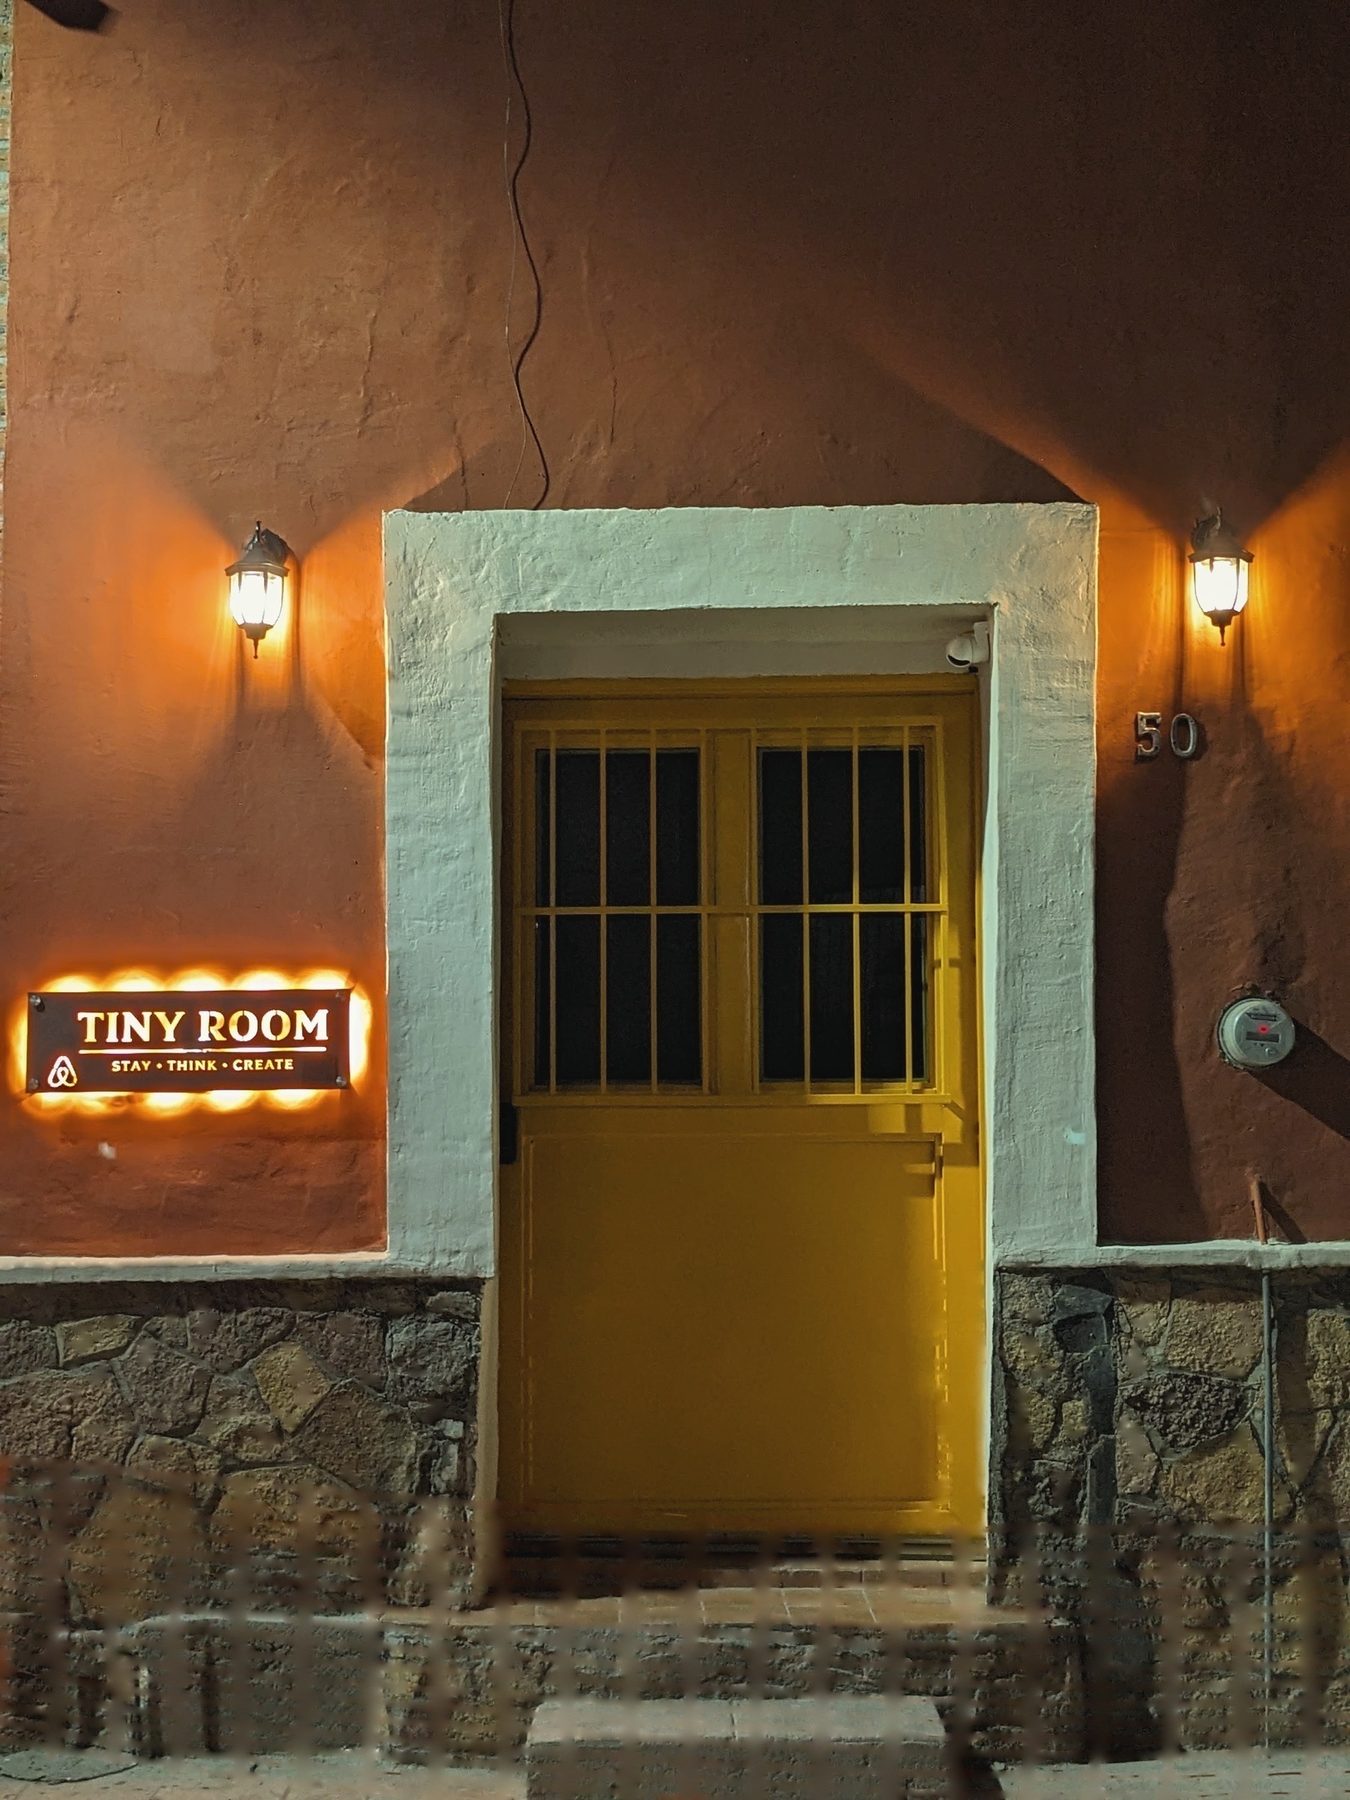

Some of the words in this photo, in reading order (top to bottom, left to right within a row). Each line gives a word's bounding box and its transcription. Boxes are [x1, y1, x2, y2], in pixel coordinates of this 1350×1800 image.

[1137, 711, 1198, 757] 50
[78, 1011, 185, 1043] TINY
[198, 1009, 328, 1041] ROOM
[111, 1060, 151, 1072] STAY
[167, 1060, 217, 1071] THINK
[232, 1059, 294, 1071] CREATE
